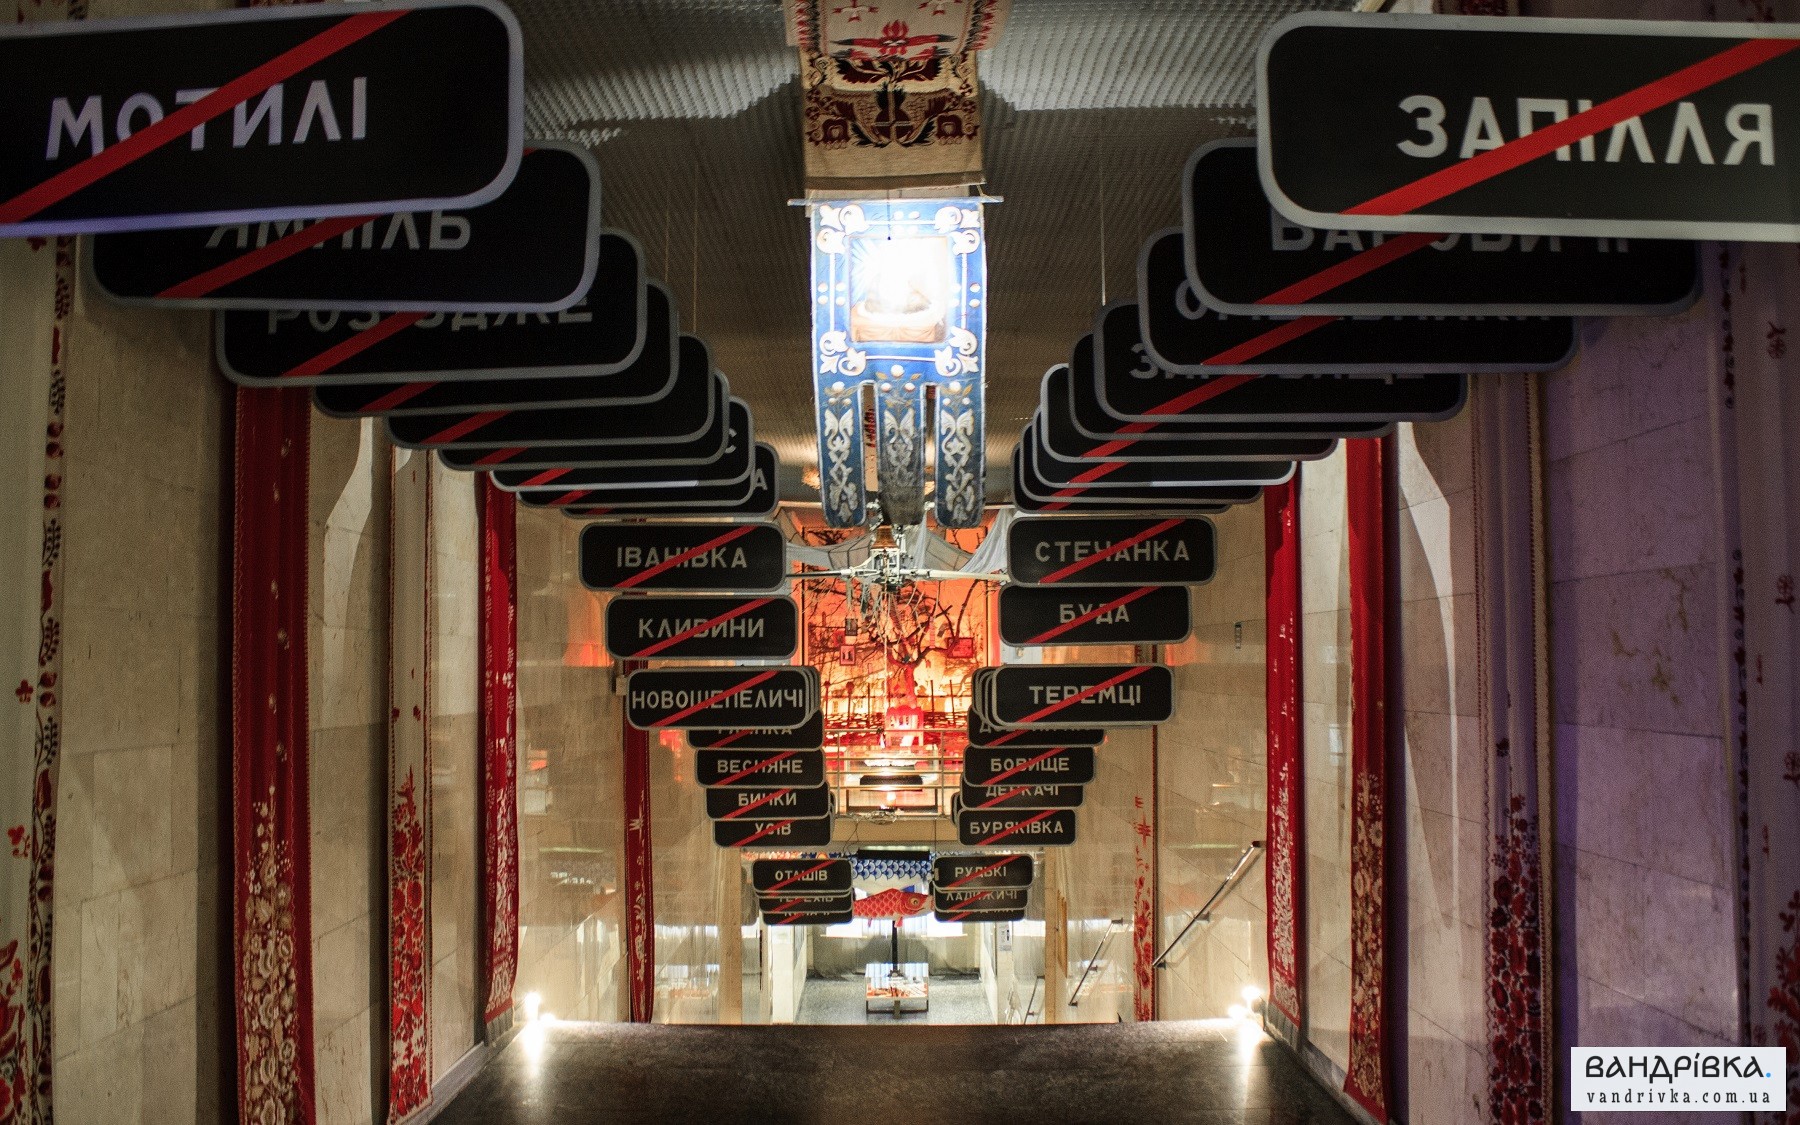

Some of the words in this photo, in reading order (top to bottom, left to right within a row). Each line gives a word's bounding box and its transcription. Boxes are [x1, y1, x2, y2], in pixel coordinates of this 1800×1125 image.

[45, 77, 367, 160] МОТИЛІ
[1397, 95, 1775, 166] ЗАПІЛЛЯ
[616, 546, 748, 569] ІВАНІВКА
[1034, 539, 1190, 563] СТЕЧАНКА
[1059, 603, 1130, 625] БУДА
[638, 617, 764, 639] КЛИВИНИ
[632, 688, 803, 710] НОВОШЕПЕЛИЧІ
[1028, 684, 1141, 706] ТЕРЕМЦІ
[990, 757, 1070, 773] БОВИЩЕ
[985, 785, 1059, 798] ДЕКАЧІ
